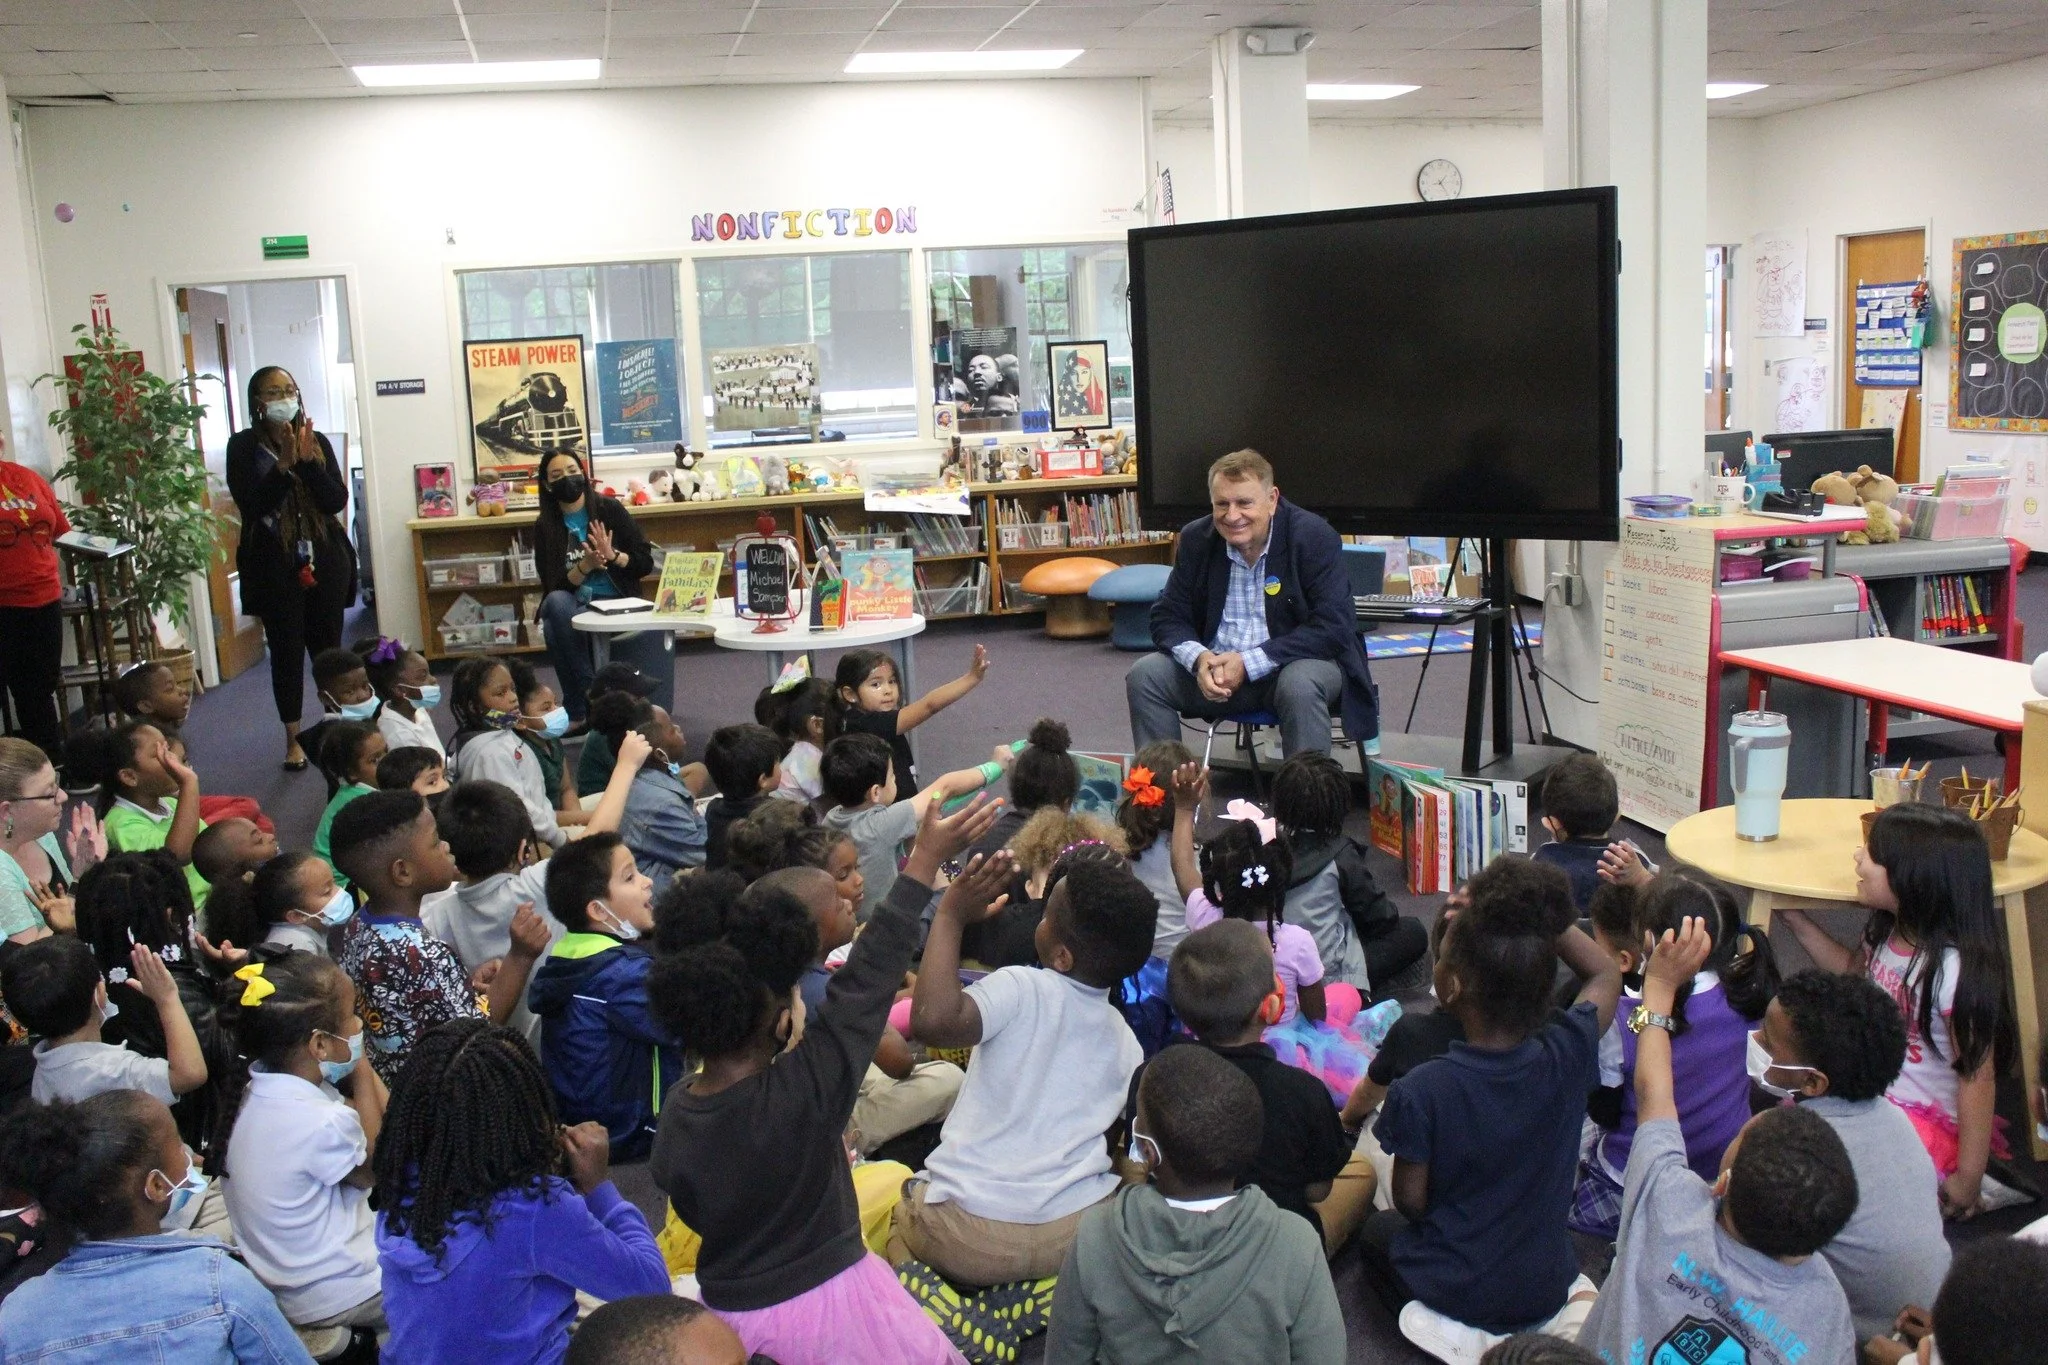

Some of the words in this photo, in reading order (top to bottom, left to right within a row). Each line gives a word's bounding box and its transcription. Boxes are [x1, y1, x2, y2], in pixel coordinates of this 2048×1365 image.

[691, 206, 917, 241] NONFICTION
[472, 347, 521, 369] STEAM
[527, 344, 577, 365] POWER
[388, 382, 399, 390] A/V
[400, 381, 424, 389] STORAGE
[1023, 415, 1047, 430] 900
[750, 570, 784, 586] Michael
[1666, 1272, 1702, 1301] Early
[1703, 1296, 1762, 1349] Childhood
[1679, 1336, 1688, 1347] B
[1692, 1350, 1701, 1359] C
